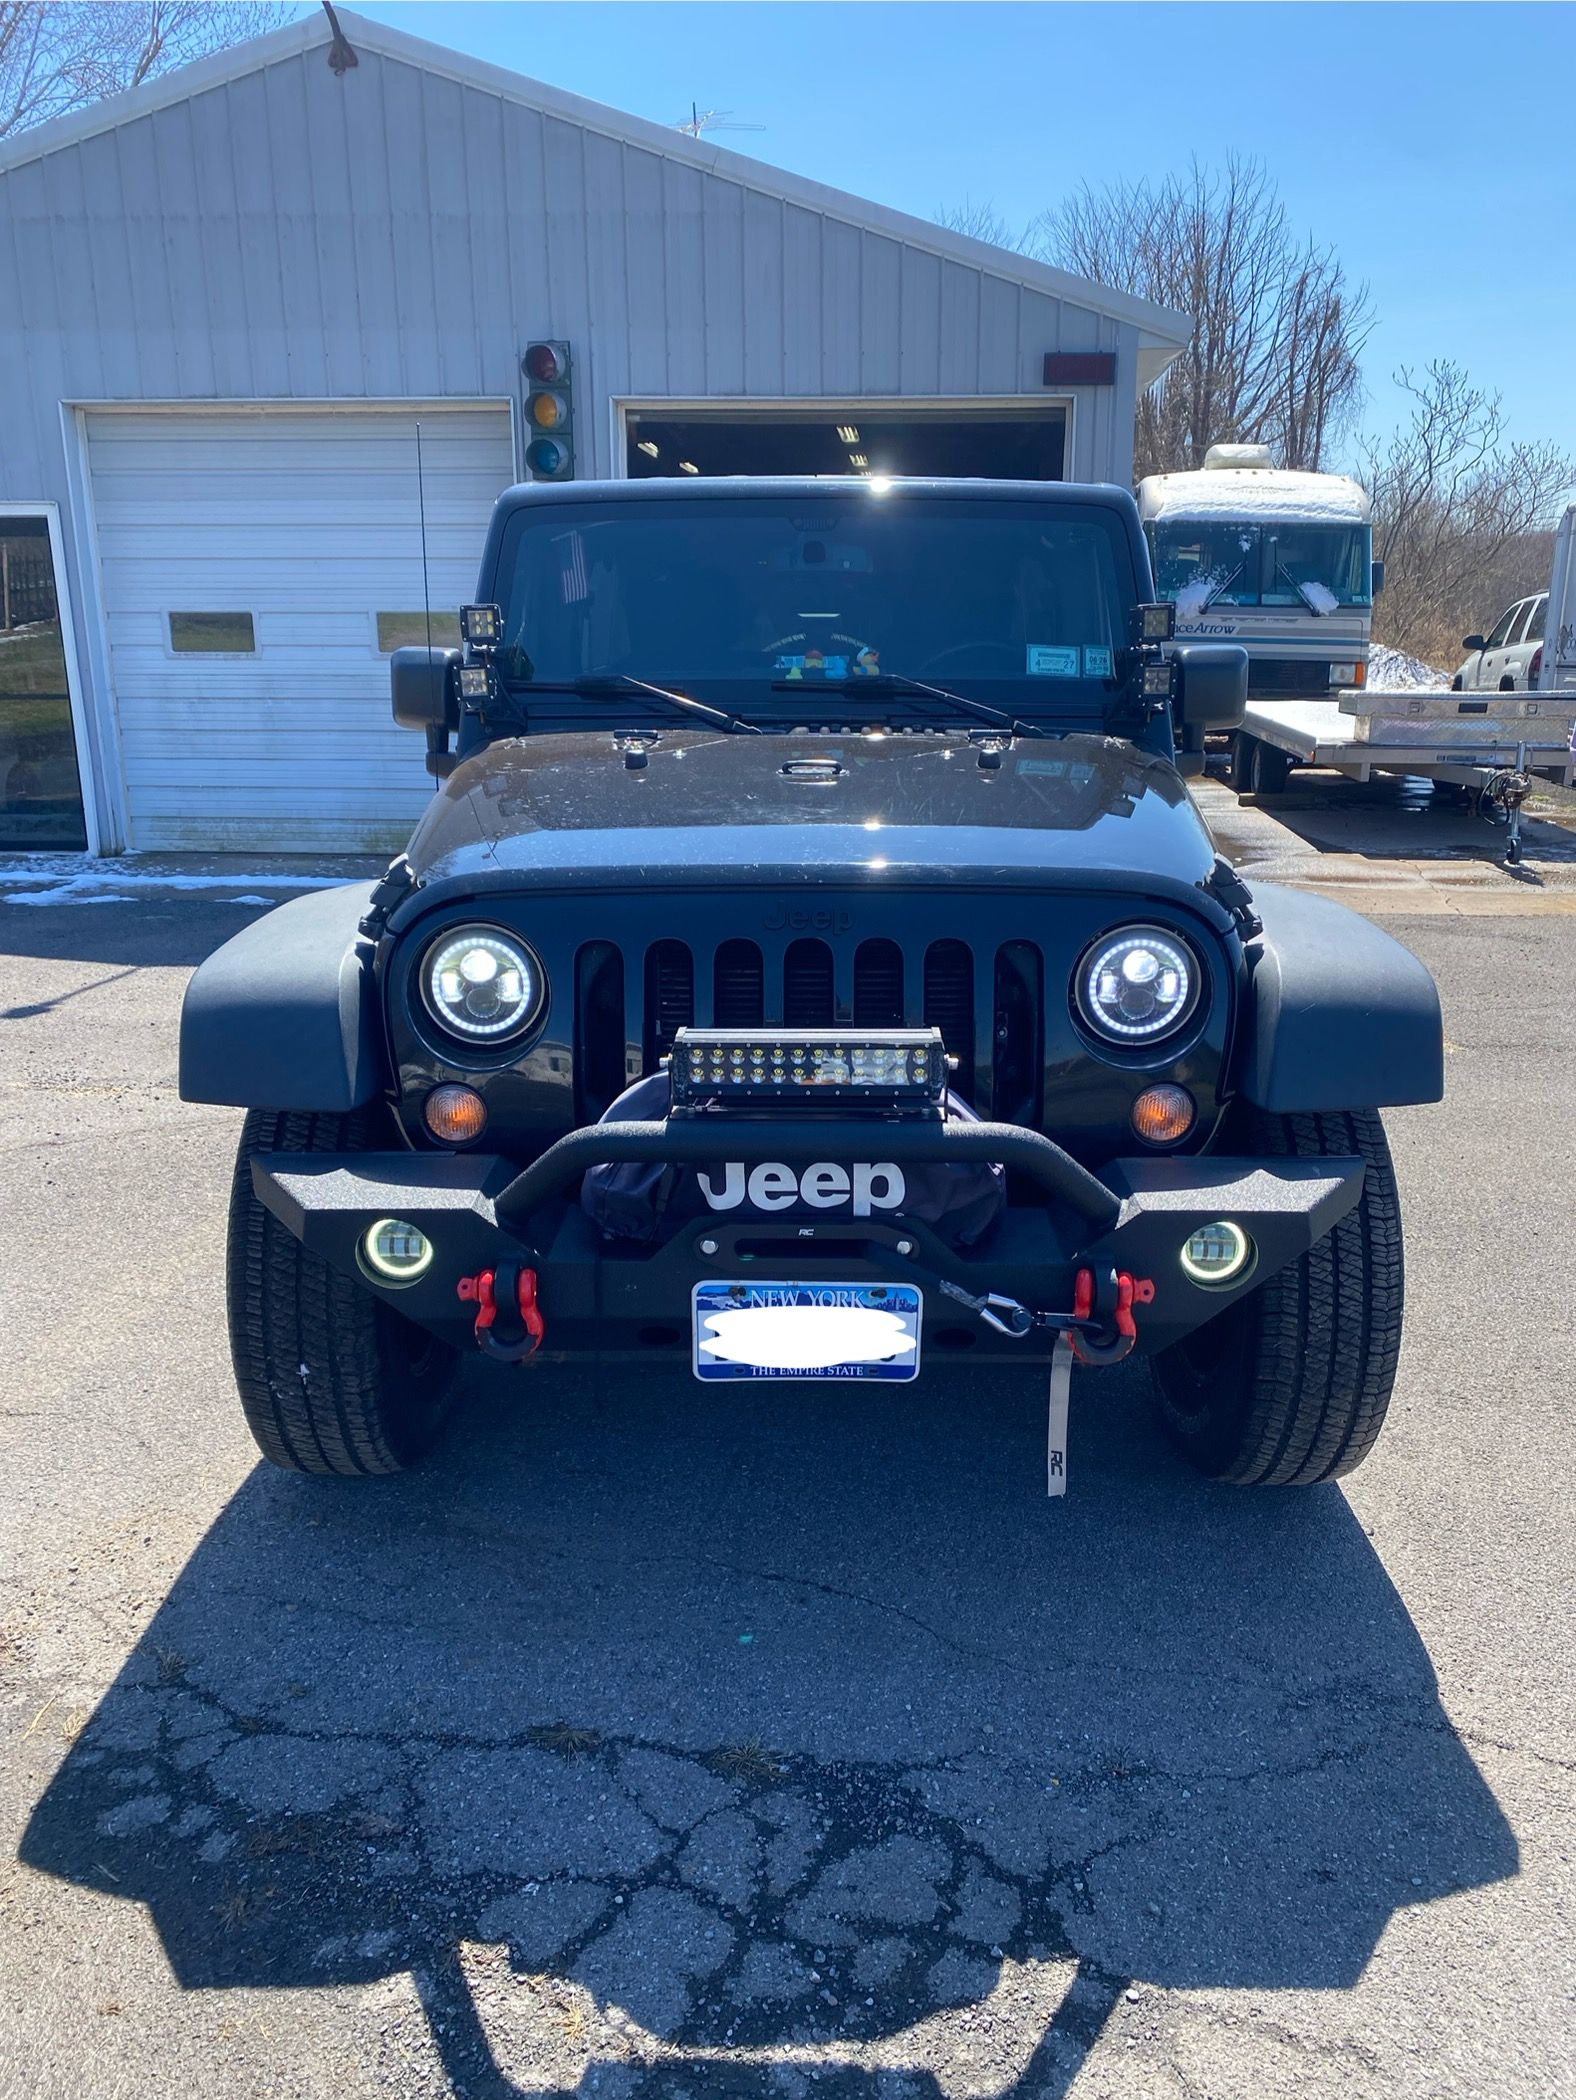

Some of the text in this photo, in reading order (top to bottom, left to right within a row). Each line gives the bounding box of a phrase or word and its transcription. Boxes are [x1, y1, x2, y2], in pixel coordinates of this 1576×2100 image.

[763, 900, 854, 936] Jeep
[696, 1162, 906, 1217] Jeep
[749, 1290, 866, 1309] NEW YORK
[750, 1366, 864, 1377] THE EMPIRE STATE
[1050, 1450, 1063, 1477] RC
